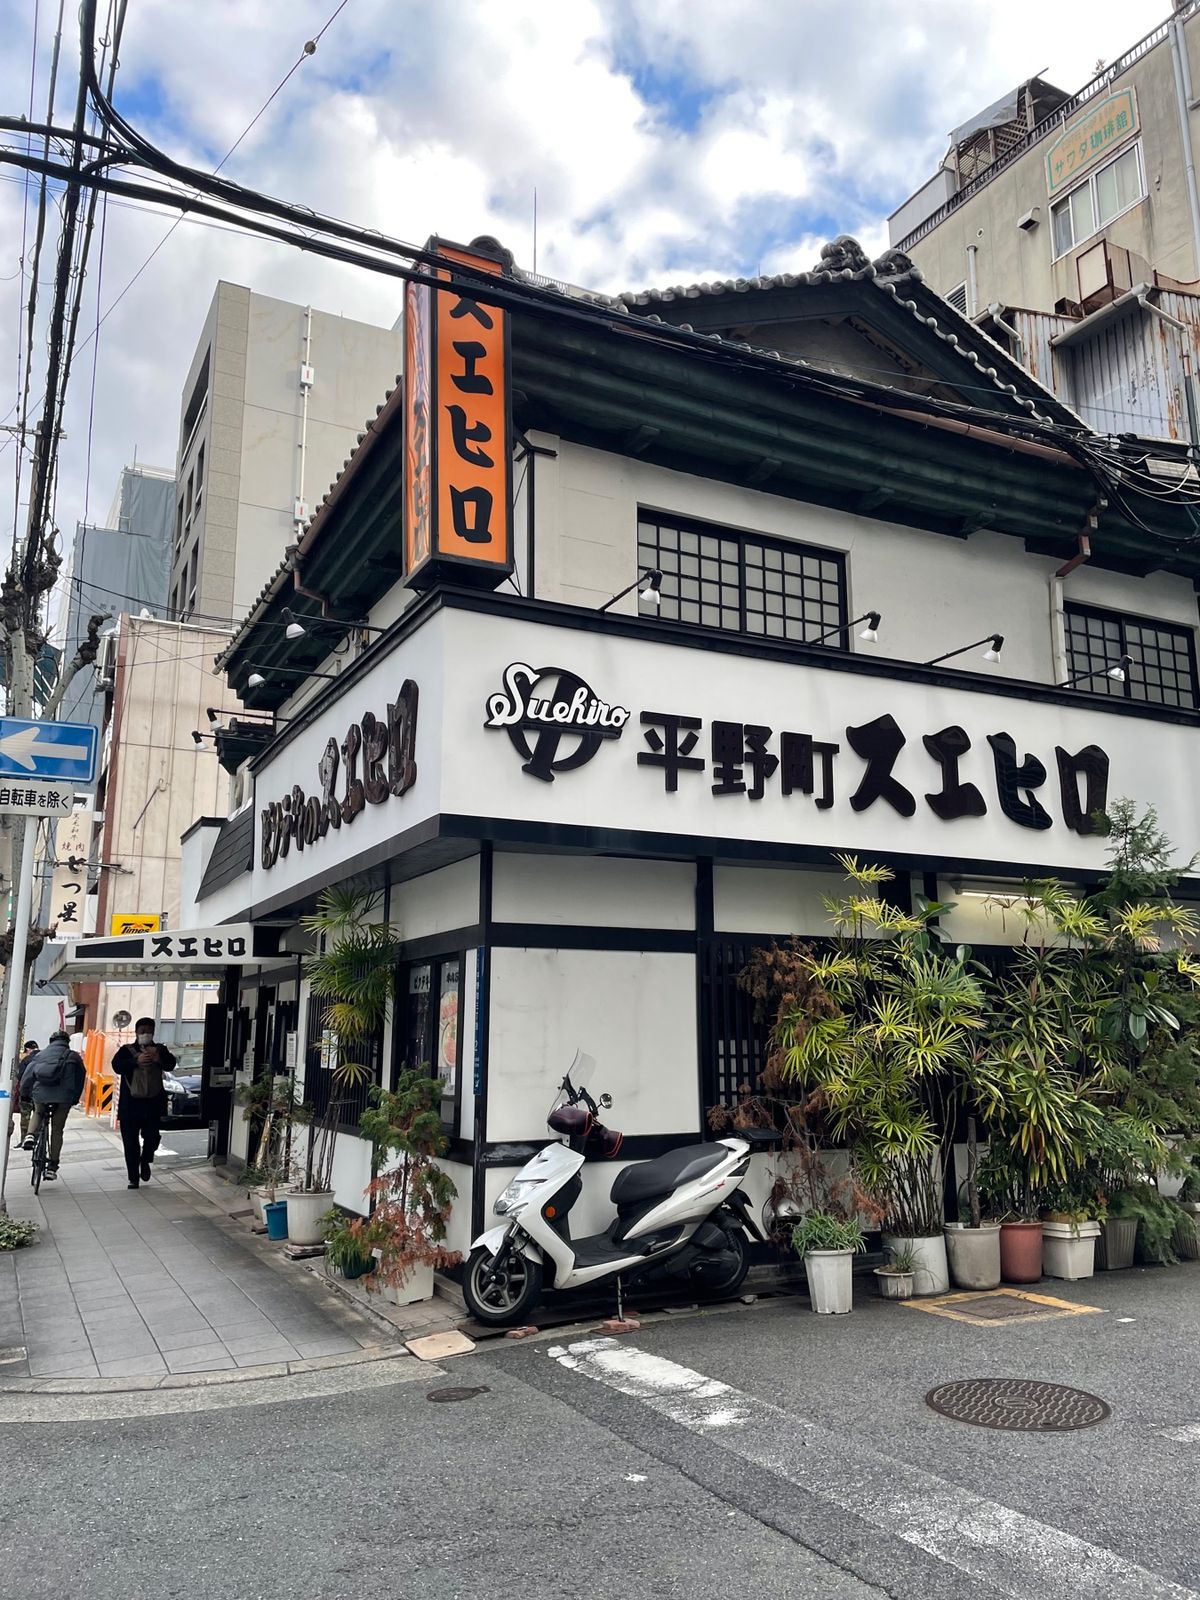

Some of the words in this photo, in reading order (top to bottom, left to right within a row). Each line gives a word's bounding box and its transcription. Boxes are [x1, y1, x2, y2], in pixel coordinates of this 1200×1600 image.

[485, 662, 631, 729] Suehiro
[0, 787, 69, 809] 自転車を除く
[120, 922, 154, 935] Times
[151, 936, 247, 958] スエヒロ
